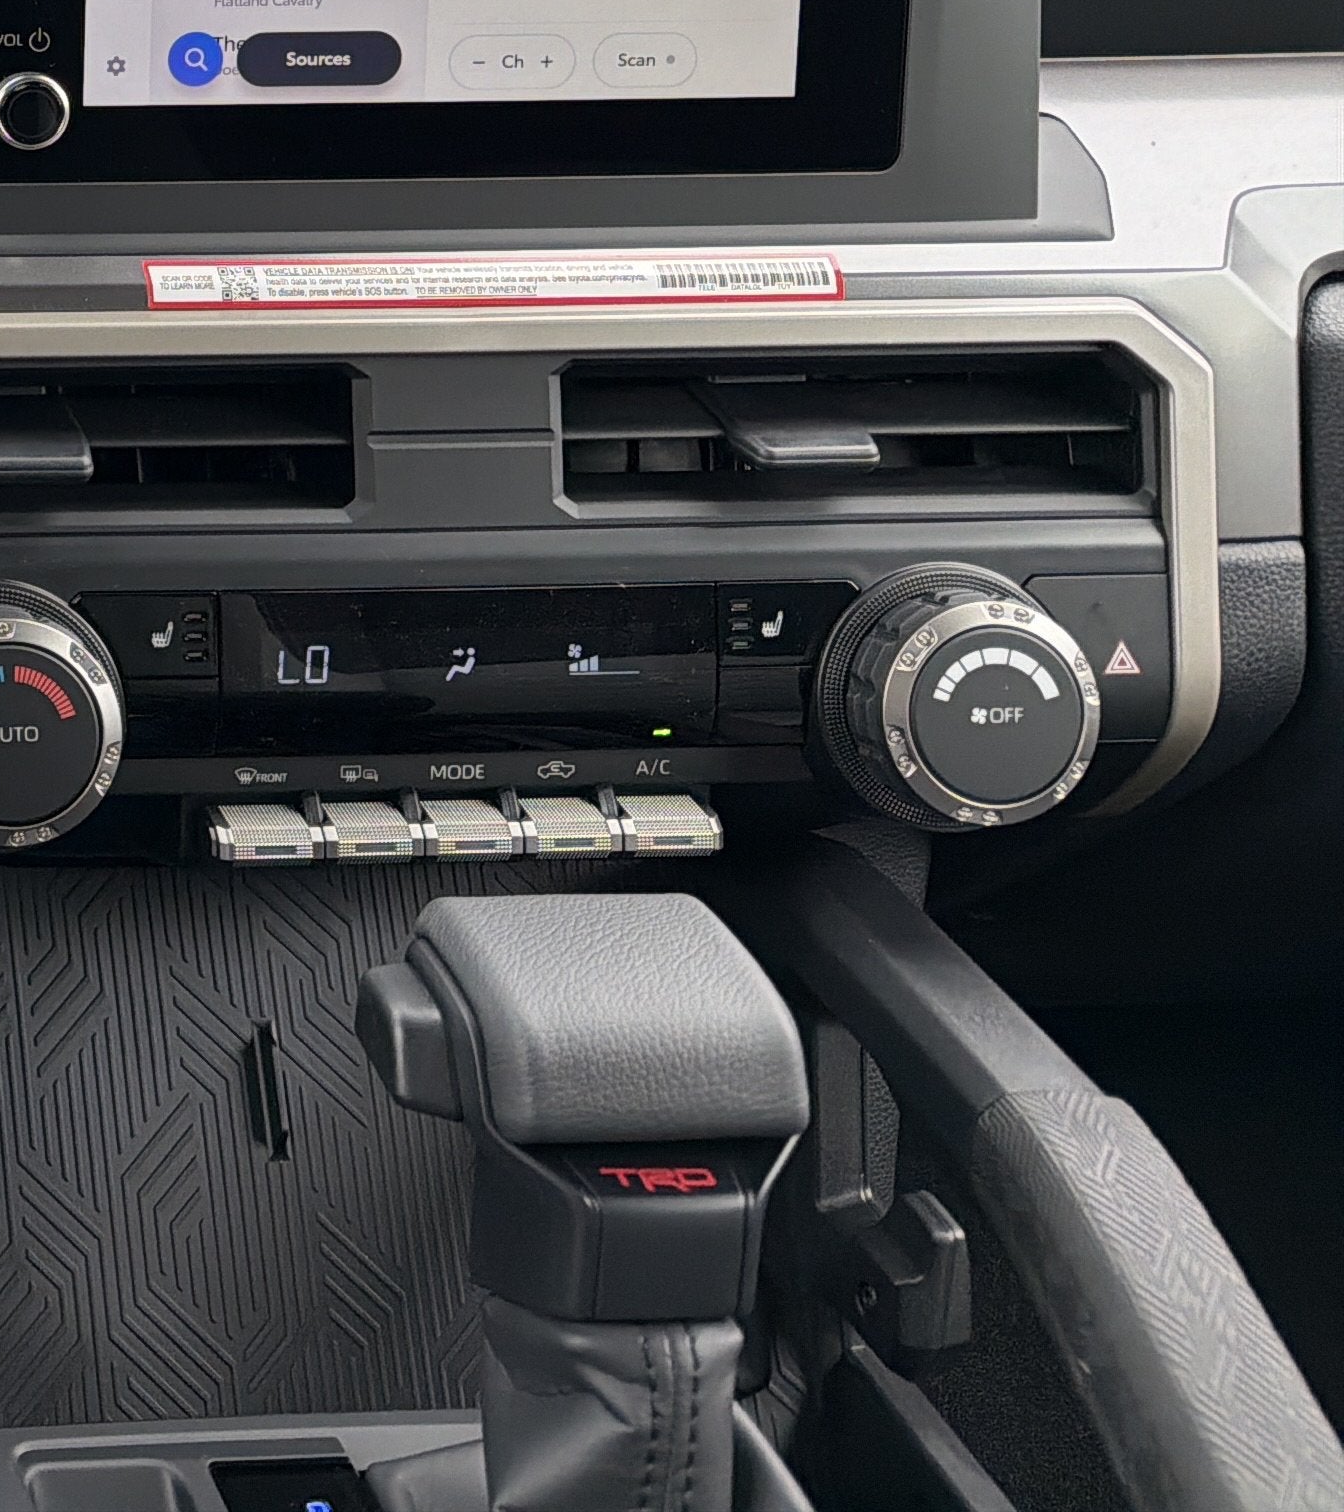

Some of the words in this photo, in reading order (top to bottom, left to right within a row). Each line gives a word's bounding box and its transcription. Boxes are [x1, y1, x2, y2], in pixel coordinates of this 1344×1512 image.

[286, 52, 351, 67] Sources
[502, 53, 524, 69] Ch
[618, 52, 656, 68] Scan
[267, 287, 276, 297] To
[365, 286, 382, 296] SOS
[989, 707, 1024, 724] OFF
[430, 764, 485, 780] MODE
[636, 759, 671, 776] A/C
[256, 771, 288, 783] FRONT
[599, 1167, 718, 1193] TRD
